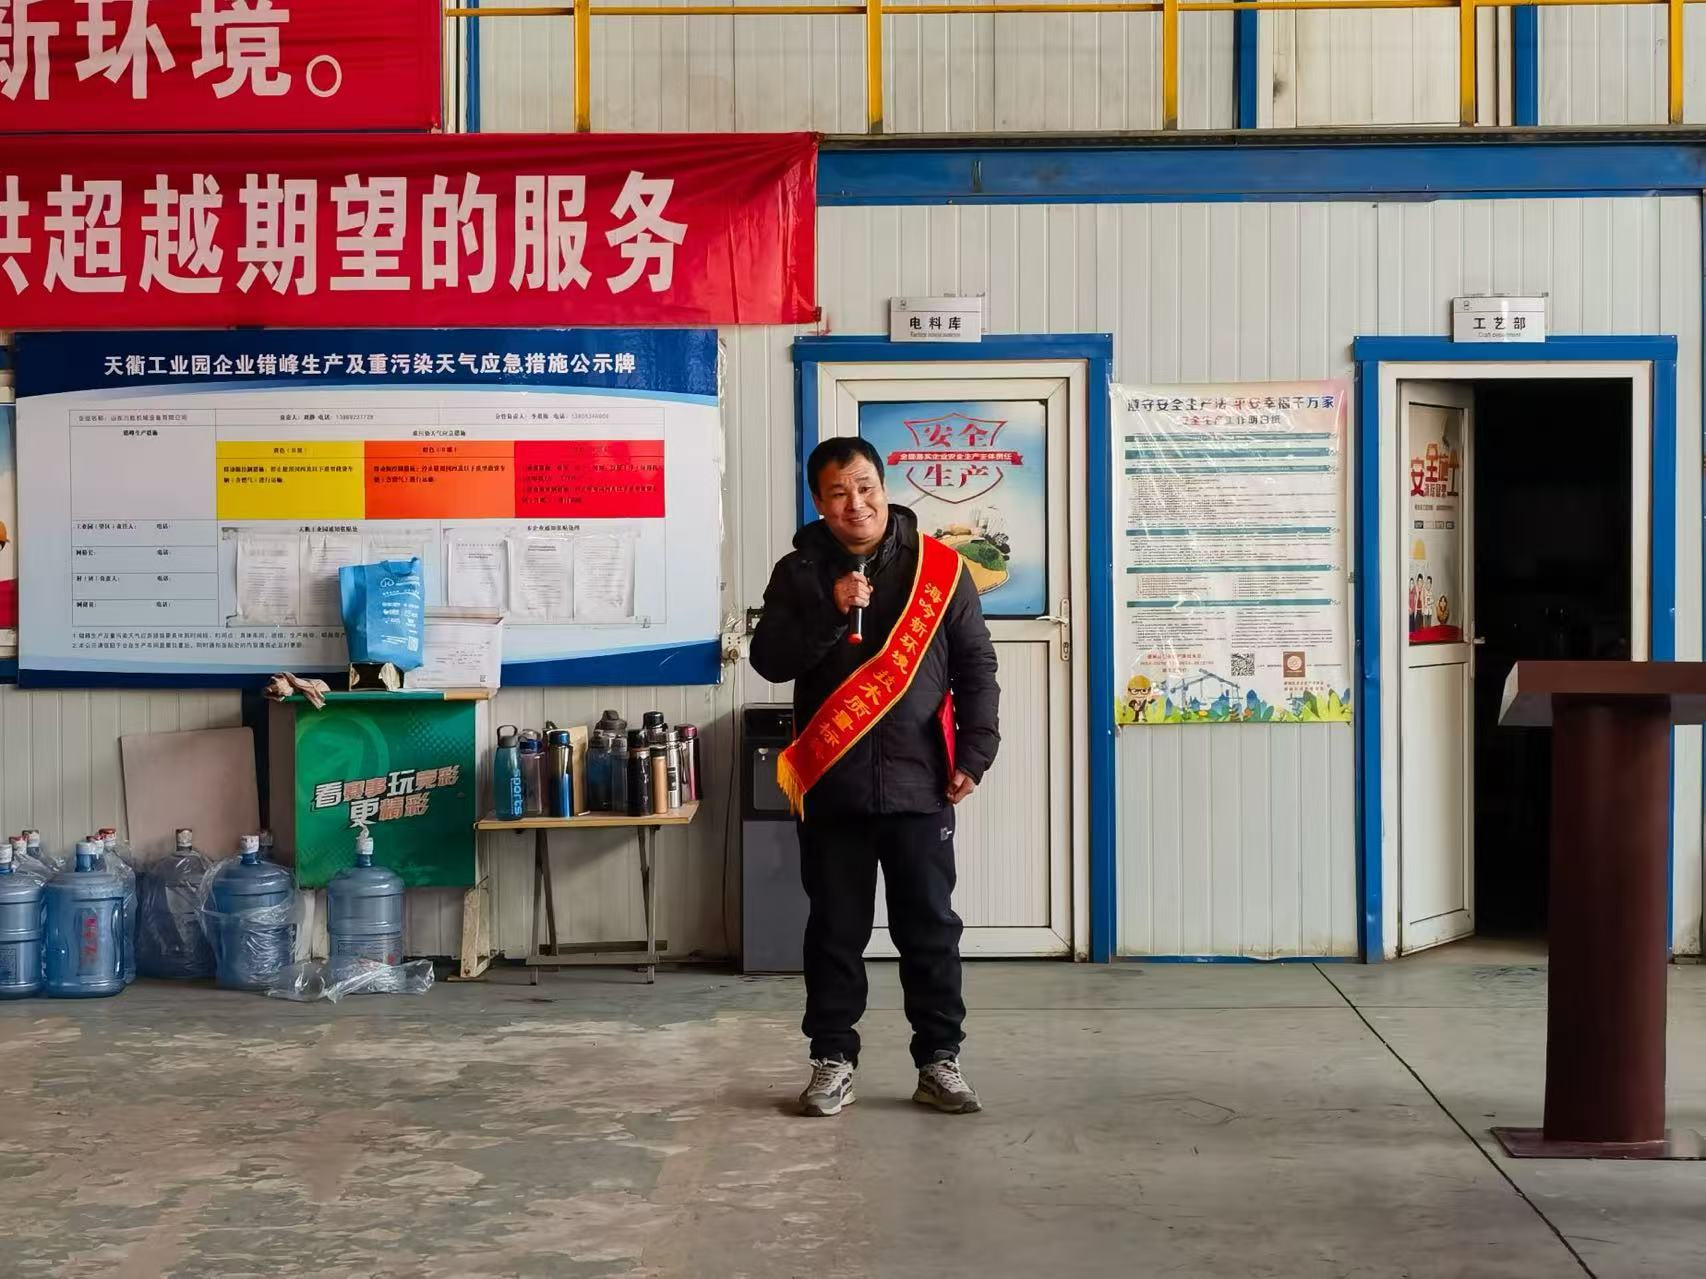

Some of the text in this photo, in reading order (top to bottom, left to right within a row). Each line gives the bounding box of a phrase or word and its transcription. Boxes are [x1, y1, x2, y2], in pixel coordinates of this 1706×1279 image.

[909, 316, 961, 330] 电料库
[1473, 316, 1526, 330] 工艺部
[104, 352, 636, 376] 天衢工业园企业错峰生产及重污染天气应急措施公示牌
[923, 423, 989, 447] 安全
[922, 463, 989, 488] 生产
[510, 767, 523, 817] sports
[349, 791, 431, 828] 更精彩
